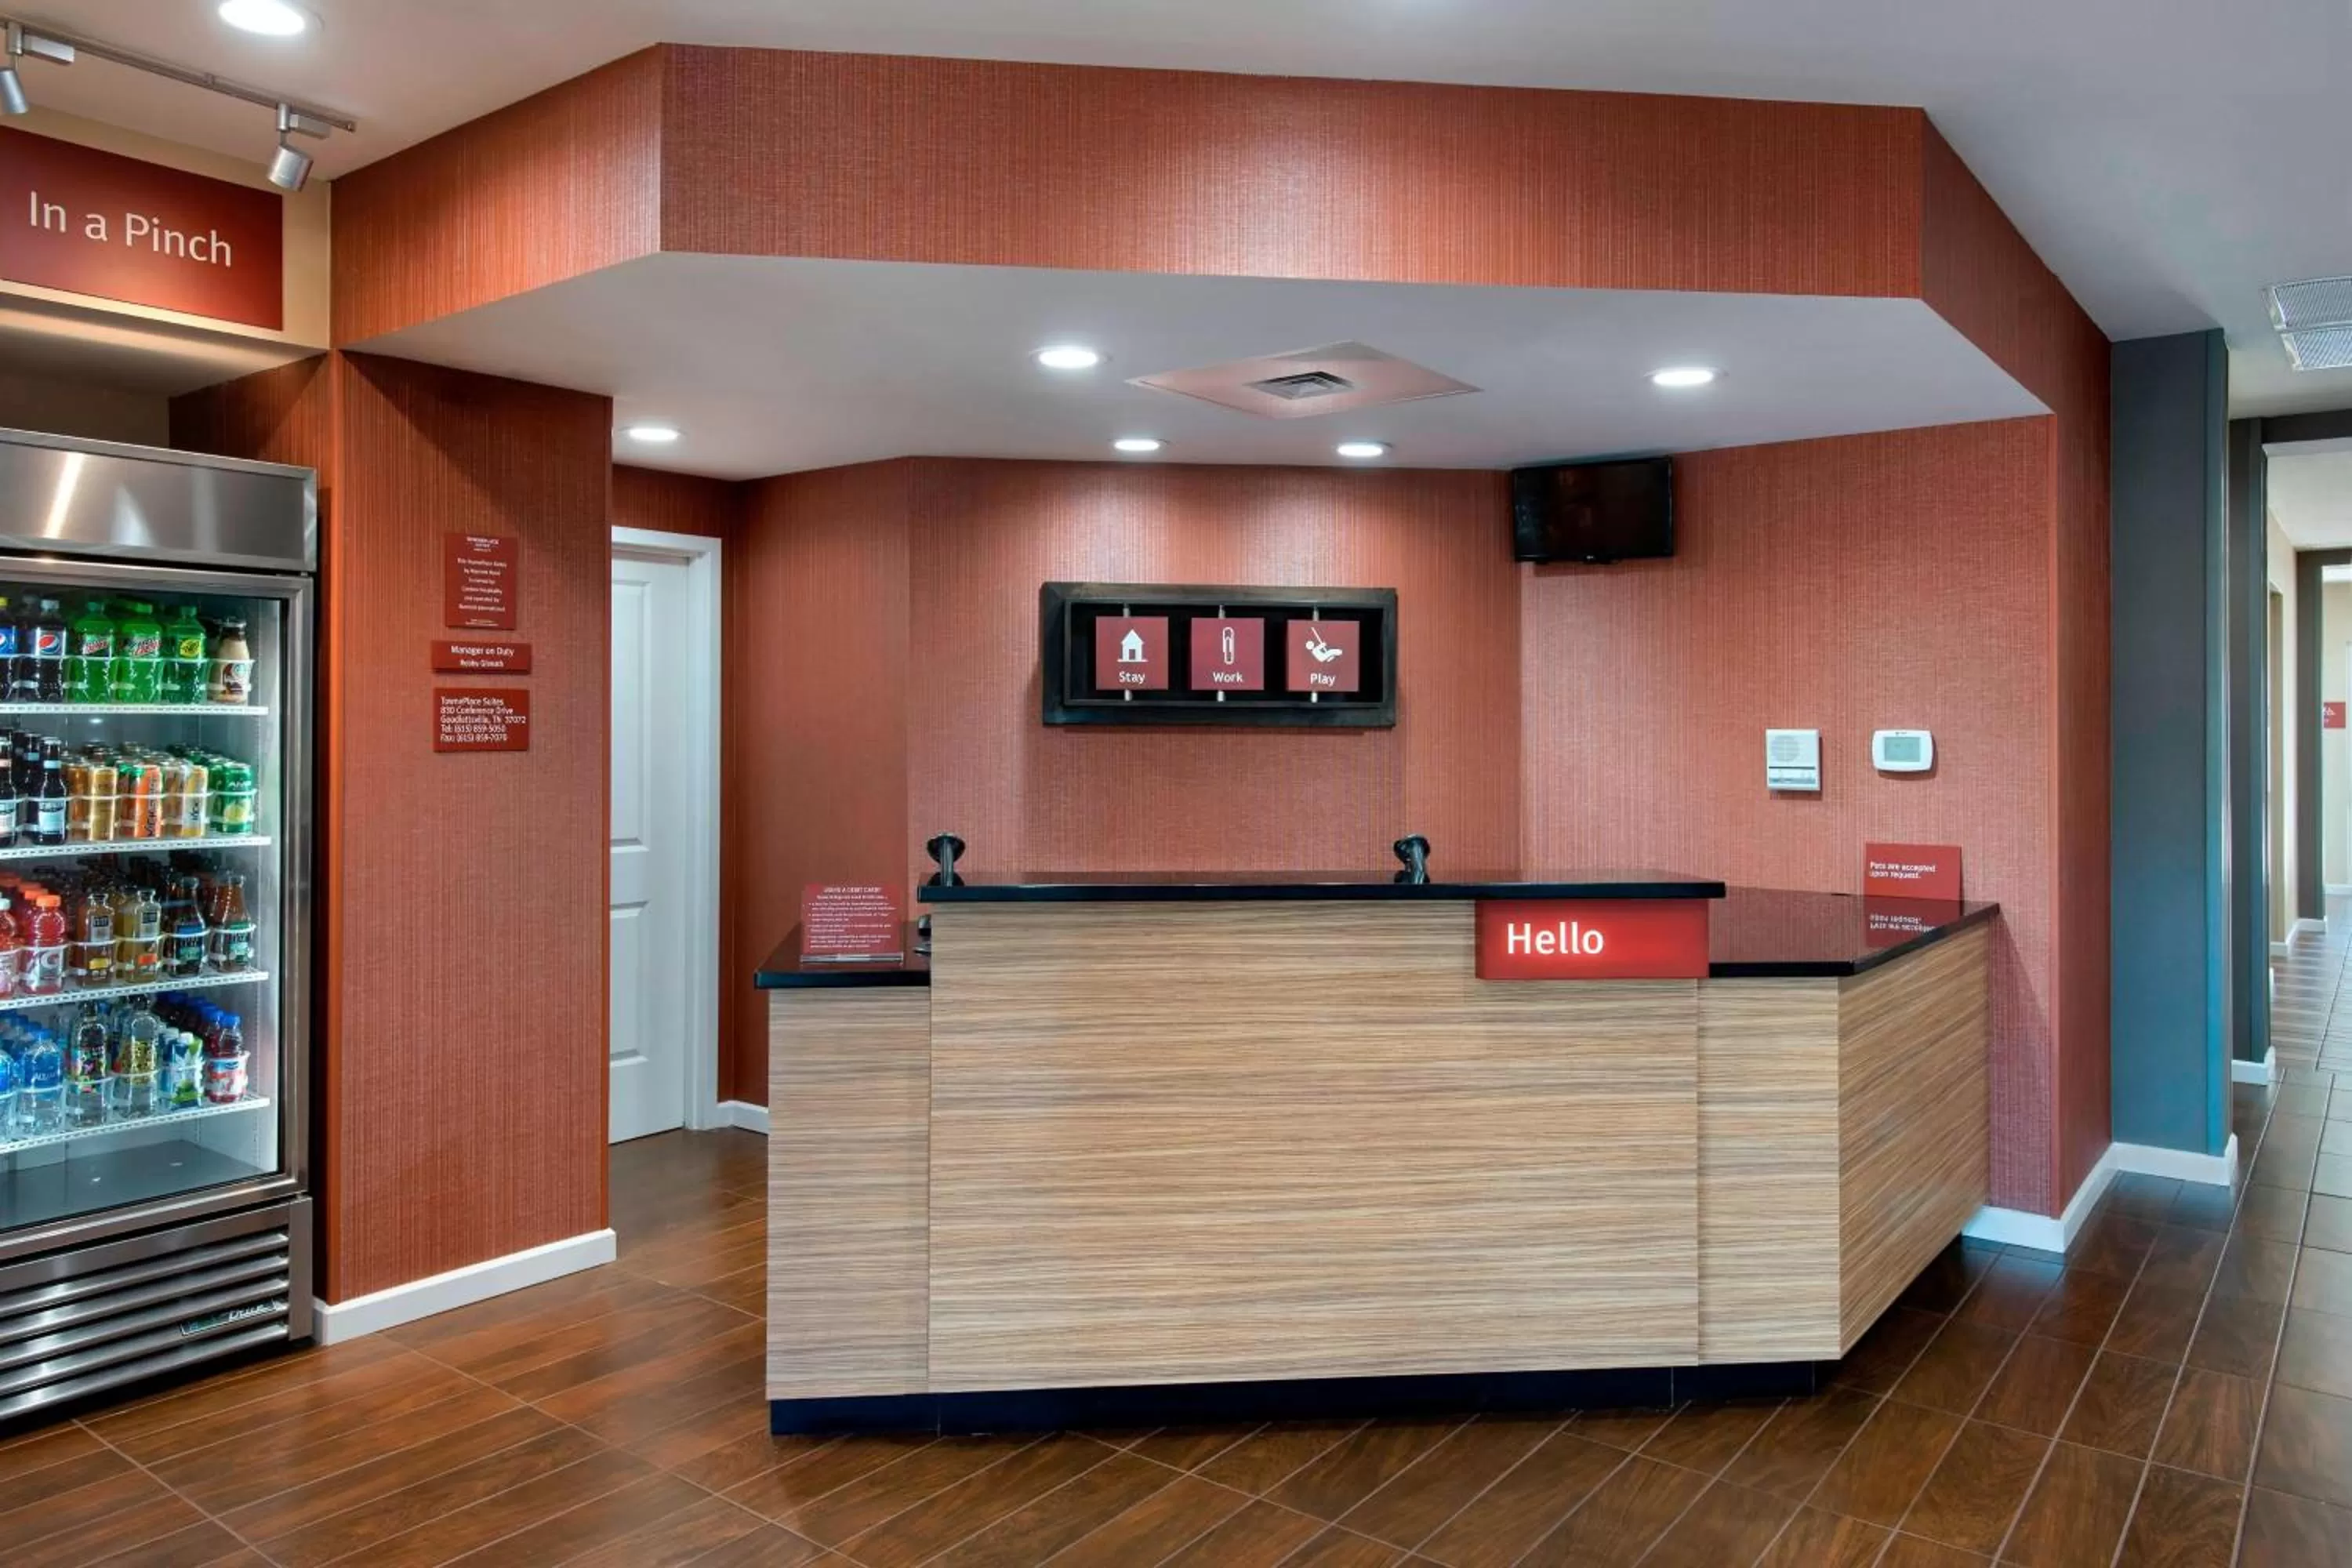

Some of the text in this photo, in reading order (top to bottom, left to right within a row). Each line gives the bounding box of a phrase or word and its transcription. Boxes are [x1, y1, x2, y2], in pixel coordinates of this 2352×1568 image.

[31, 191, 232, 267] In a Pinch
[451, 645, 484, 656] Manager
[496, 647, 514, 656] Duty
[1119, 671, 1145, 684] Stay
[1213, 672, 1243, 683] Work
[1310, 673, 1336, 685] Play
[441, 696, 504, 706] TownePlace Suites
[456, 706, 494, 715] Conference
[1507, 921, 1604, 955] Hello
